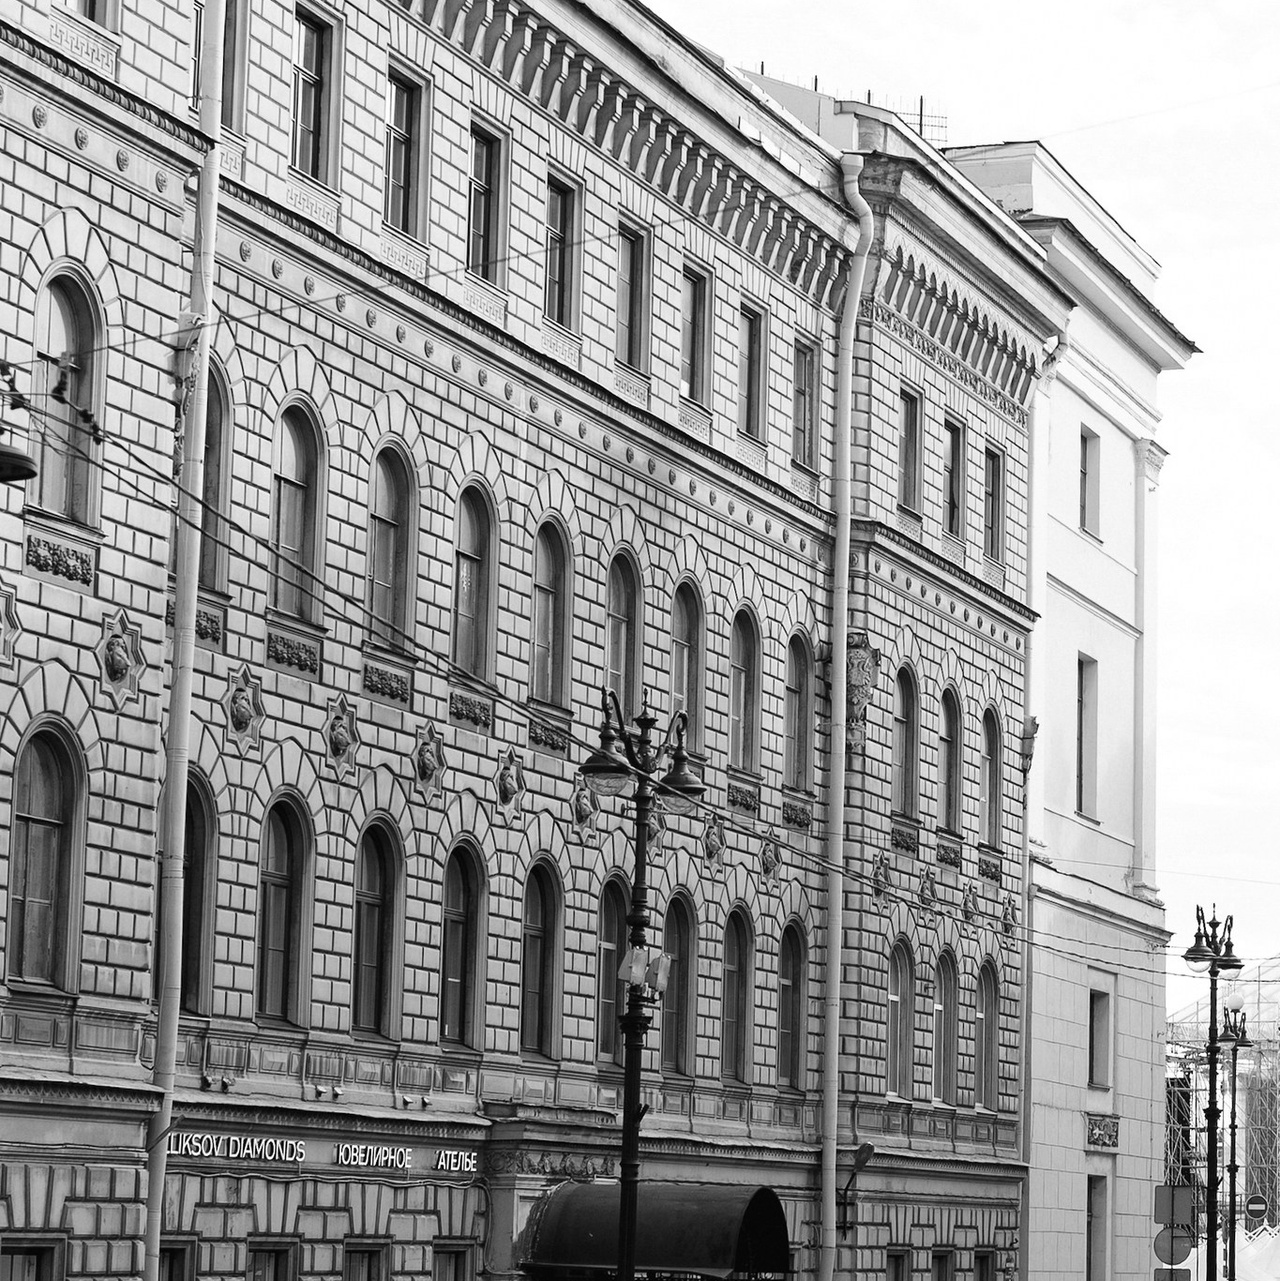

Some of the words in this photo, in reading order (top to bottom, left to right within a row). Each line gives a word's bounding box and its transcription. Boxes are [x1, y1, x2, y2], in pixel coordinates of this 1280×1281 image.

[229, 1136, 305, 1161] DIAMONDS
[338, 1143, 413, 1168] ЮВЕЛИРНОЕ
[437, 1150, 477, 1172] АТЕЛЬЕ
